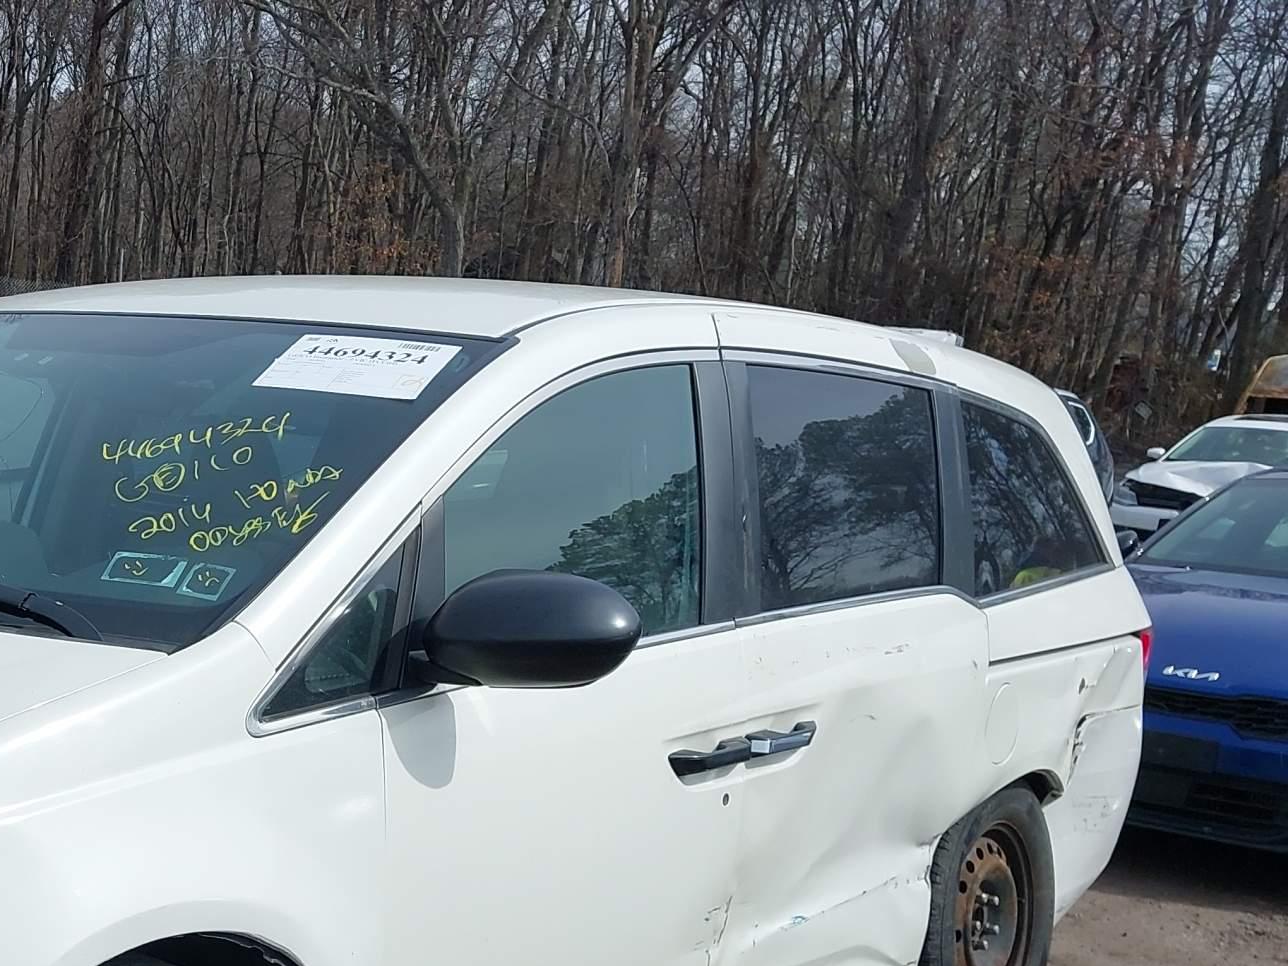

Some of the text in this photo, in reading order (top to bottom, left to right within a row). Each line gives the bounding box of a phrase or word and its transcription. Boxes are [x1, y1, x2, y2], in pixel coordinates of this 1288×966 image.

[303, 345, 429, 365] 44694324
[102, 412, 291, 464] 44694324
[128, 503, 211, 539] 2014
